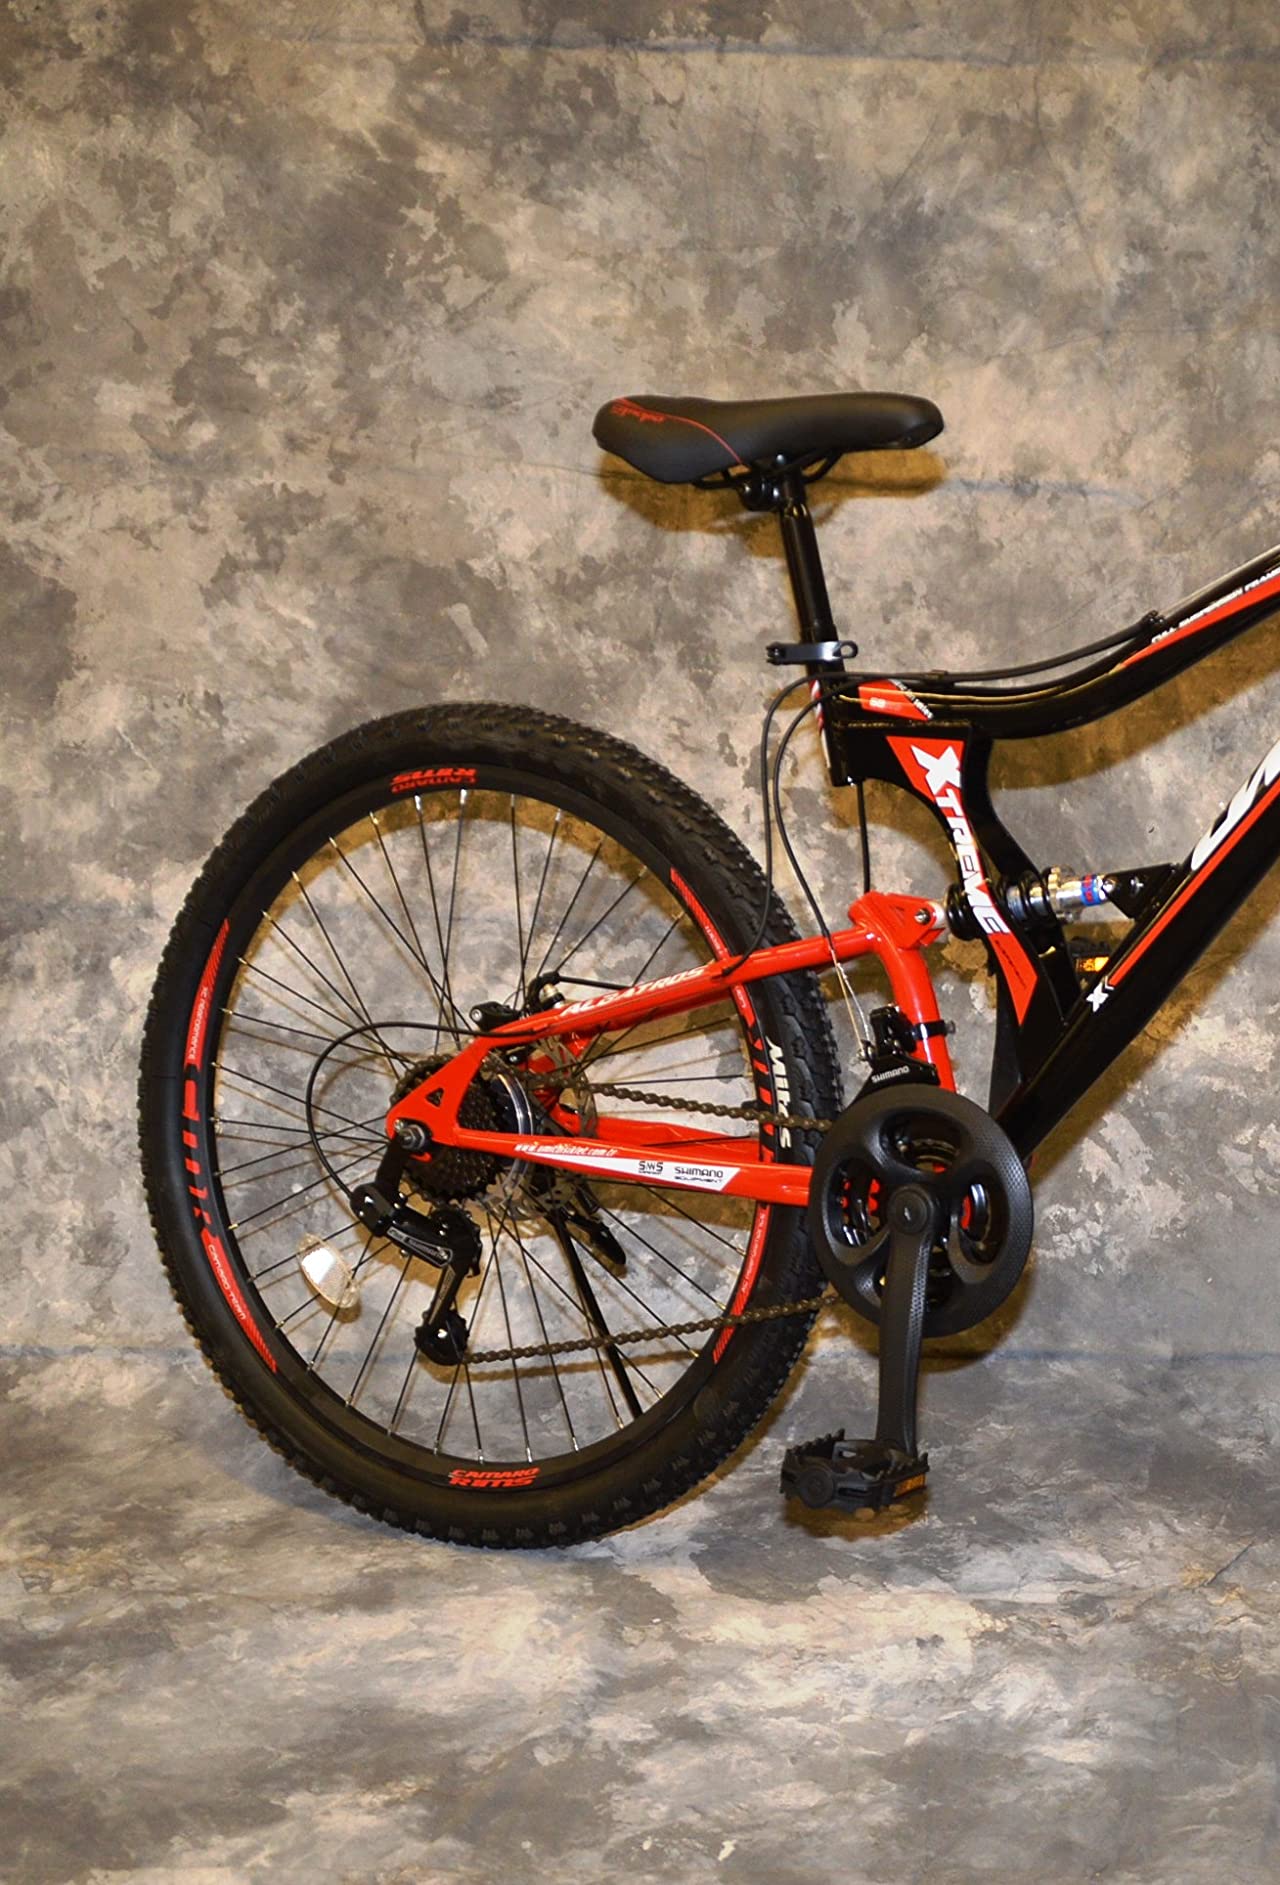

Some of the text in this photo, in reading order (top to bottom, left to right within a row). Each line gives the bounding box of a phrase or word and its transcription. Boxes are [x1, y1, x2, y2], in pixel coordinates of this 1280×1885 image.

[911, 744, 1011, 935] XTREME
[559, 964, 709, 1017] ALBATROS
[871, 1065, 910, 1083] SHIMANO
[674, 1166, 724, 1178] SHIMANO
[450, 1467, 540, 1479] CAMARO
